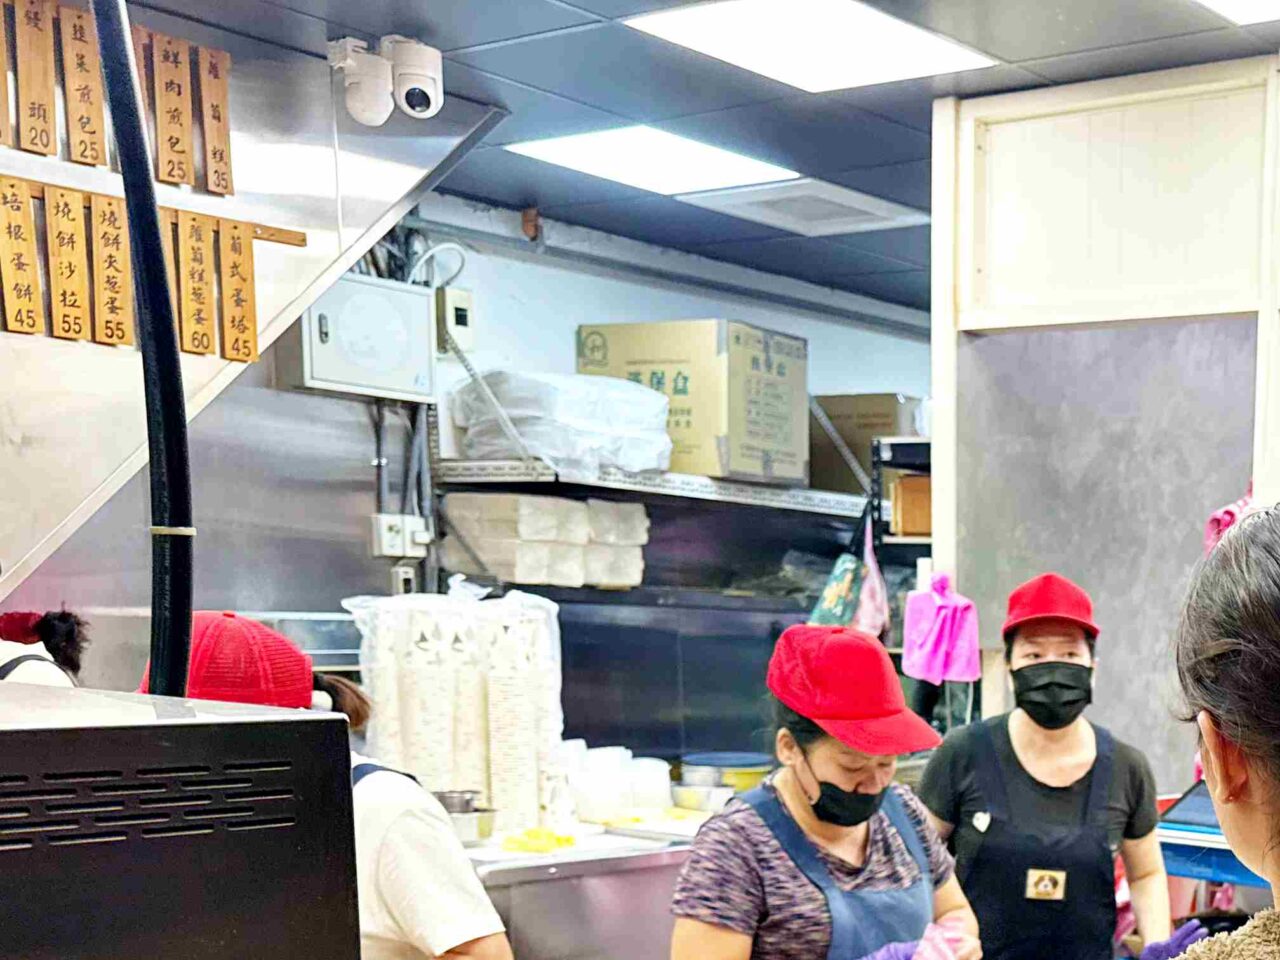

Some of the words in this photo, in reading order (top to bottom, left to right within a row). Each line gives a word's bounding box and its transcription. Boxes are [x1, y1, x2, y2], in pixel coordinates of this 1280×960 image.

[160, 50, 186, 154] 鮮肉煎包
[29, 127, 50, 149] 20
[79, 140, 99, 161] 25
[167, 160, 186, 180] 25
[213, 169, 228, 190] 35
[53, 201, 81, 309] 燒餅沙拉
[14, 309, 36, 328] 45
[61, 314, 82, 335] 55
[104, 319, 125, 340] 55
[191, 330, 210, 350] 60
[231, 337, 251, 357] 45
